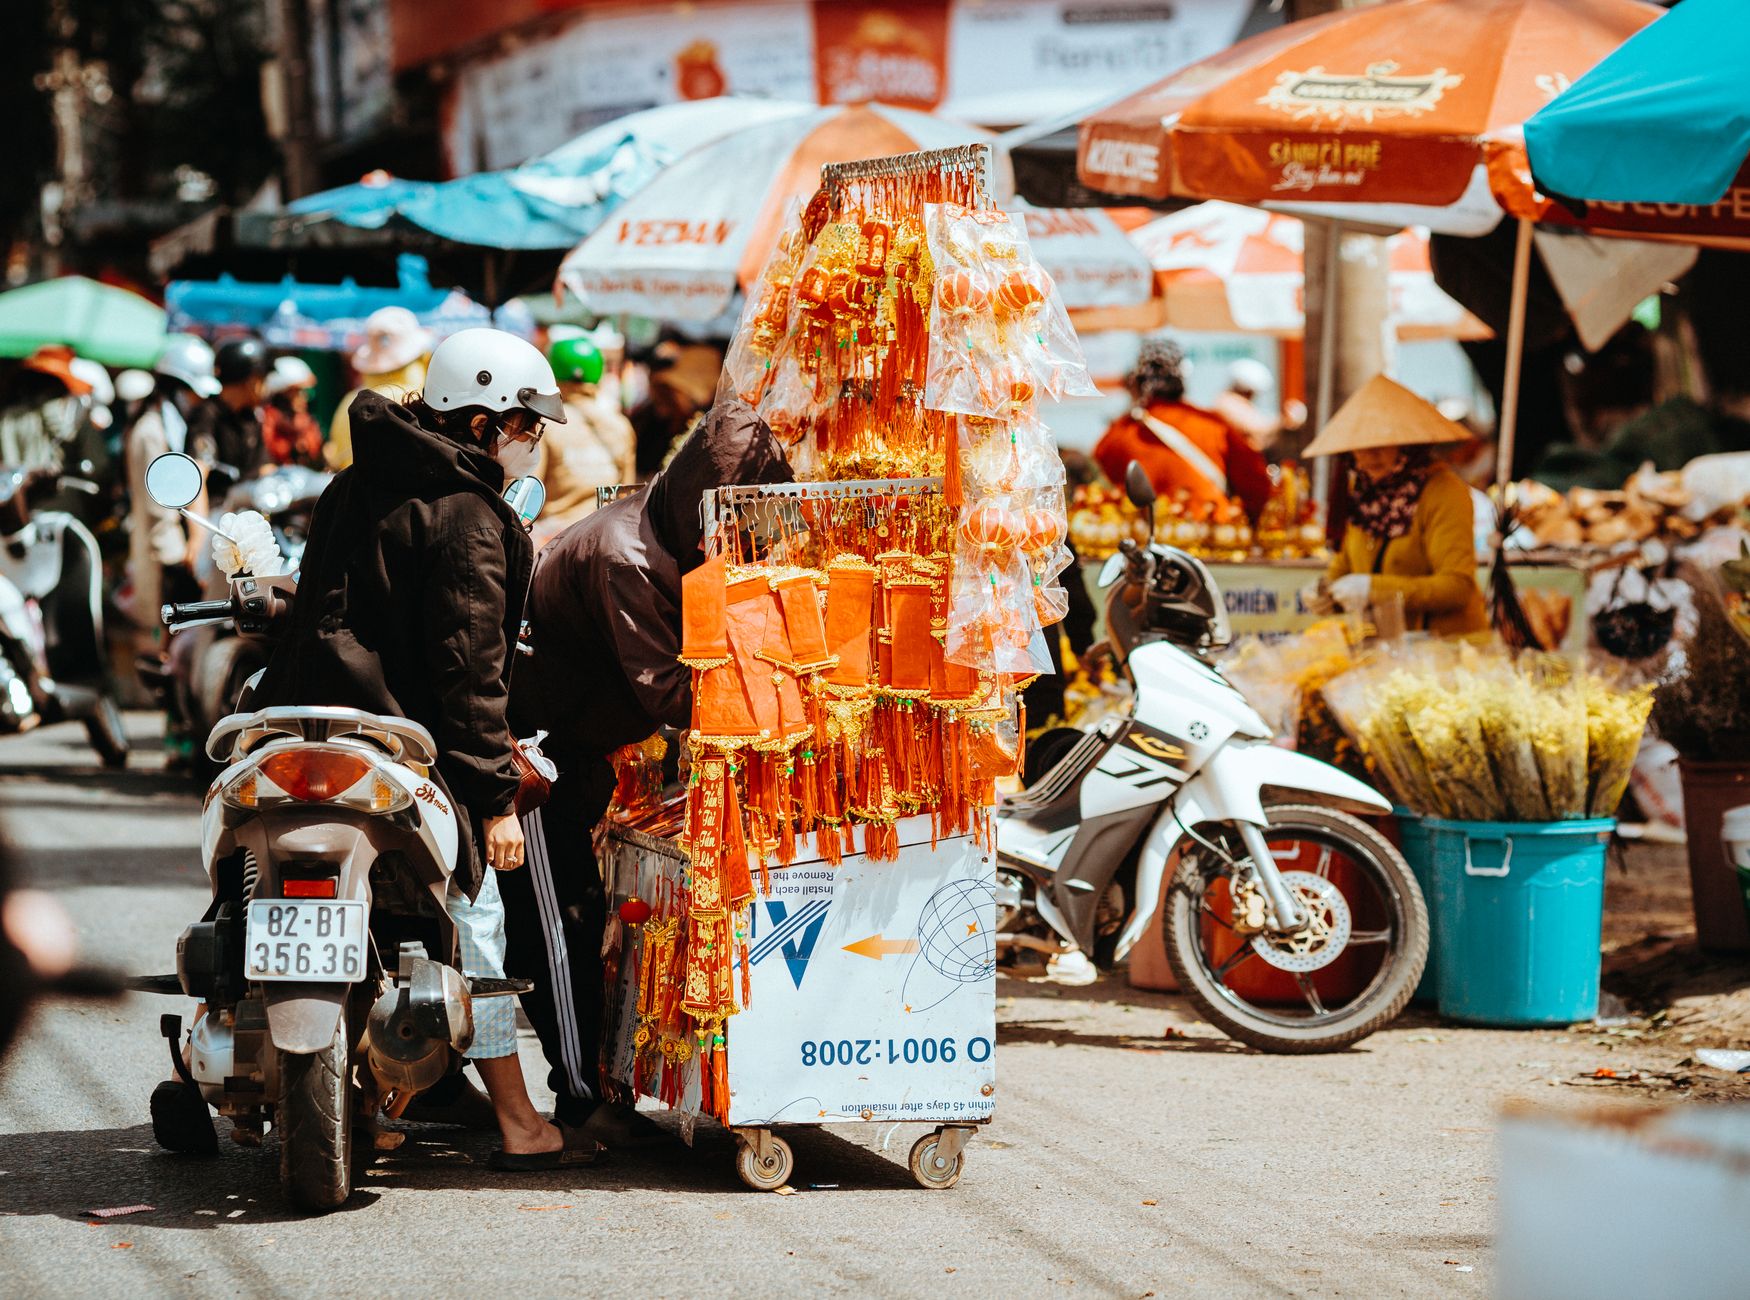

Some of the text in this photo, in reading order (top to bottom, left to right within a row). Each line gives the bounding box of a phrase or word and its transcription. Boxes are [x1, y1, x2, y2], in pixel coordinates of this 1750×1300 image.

[773, 872, 789, 882] the
[792, 872, 834, 882] Remove
[775, 886, 800, 896] each
[802, 885, 834, 895] Install
[267, 906, 346, 938] 82-B1
[254, 942, 359, 975] 356.36
[800, 1036, 996, 1067] O 9001:2008
[900, 1101, 923, 1112] after
[926, 1100, 951, 1111] days
[953, 1101, 966, 1111] 45
